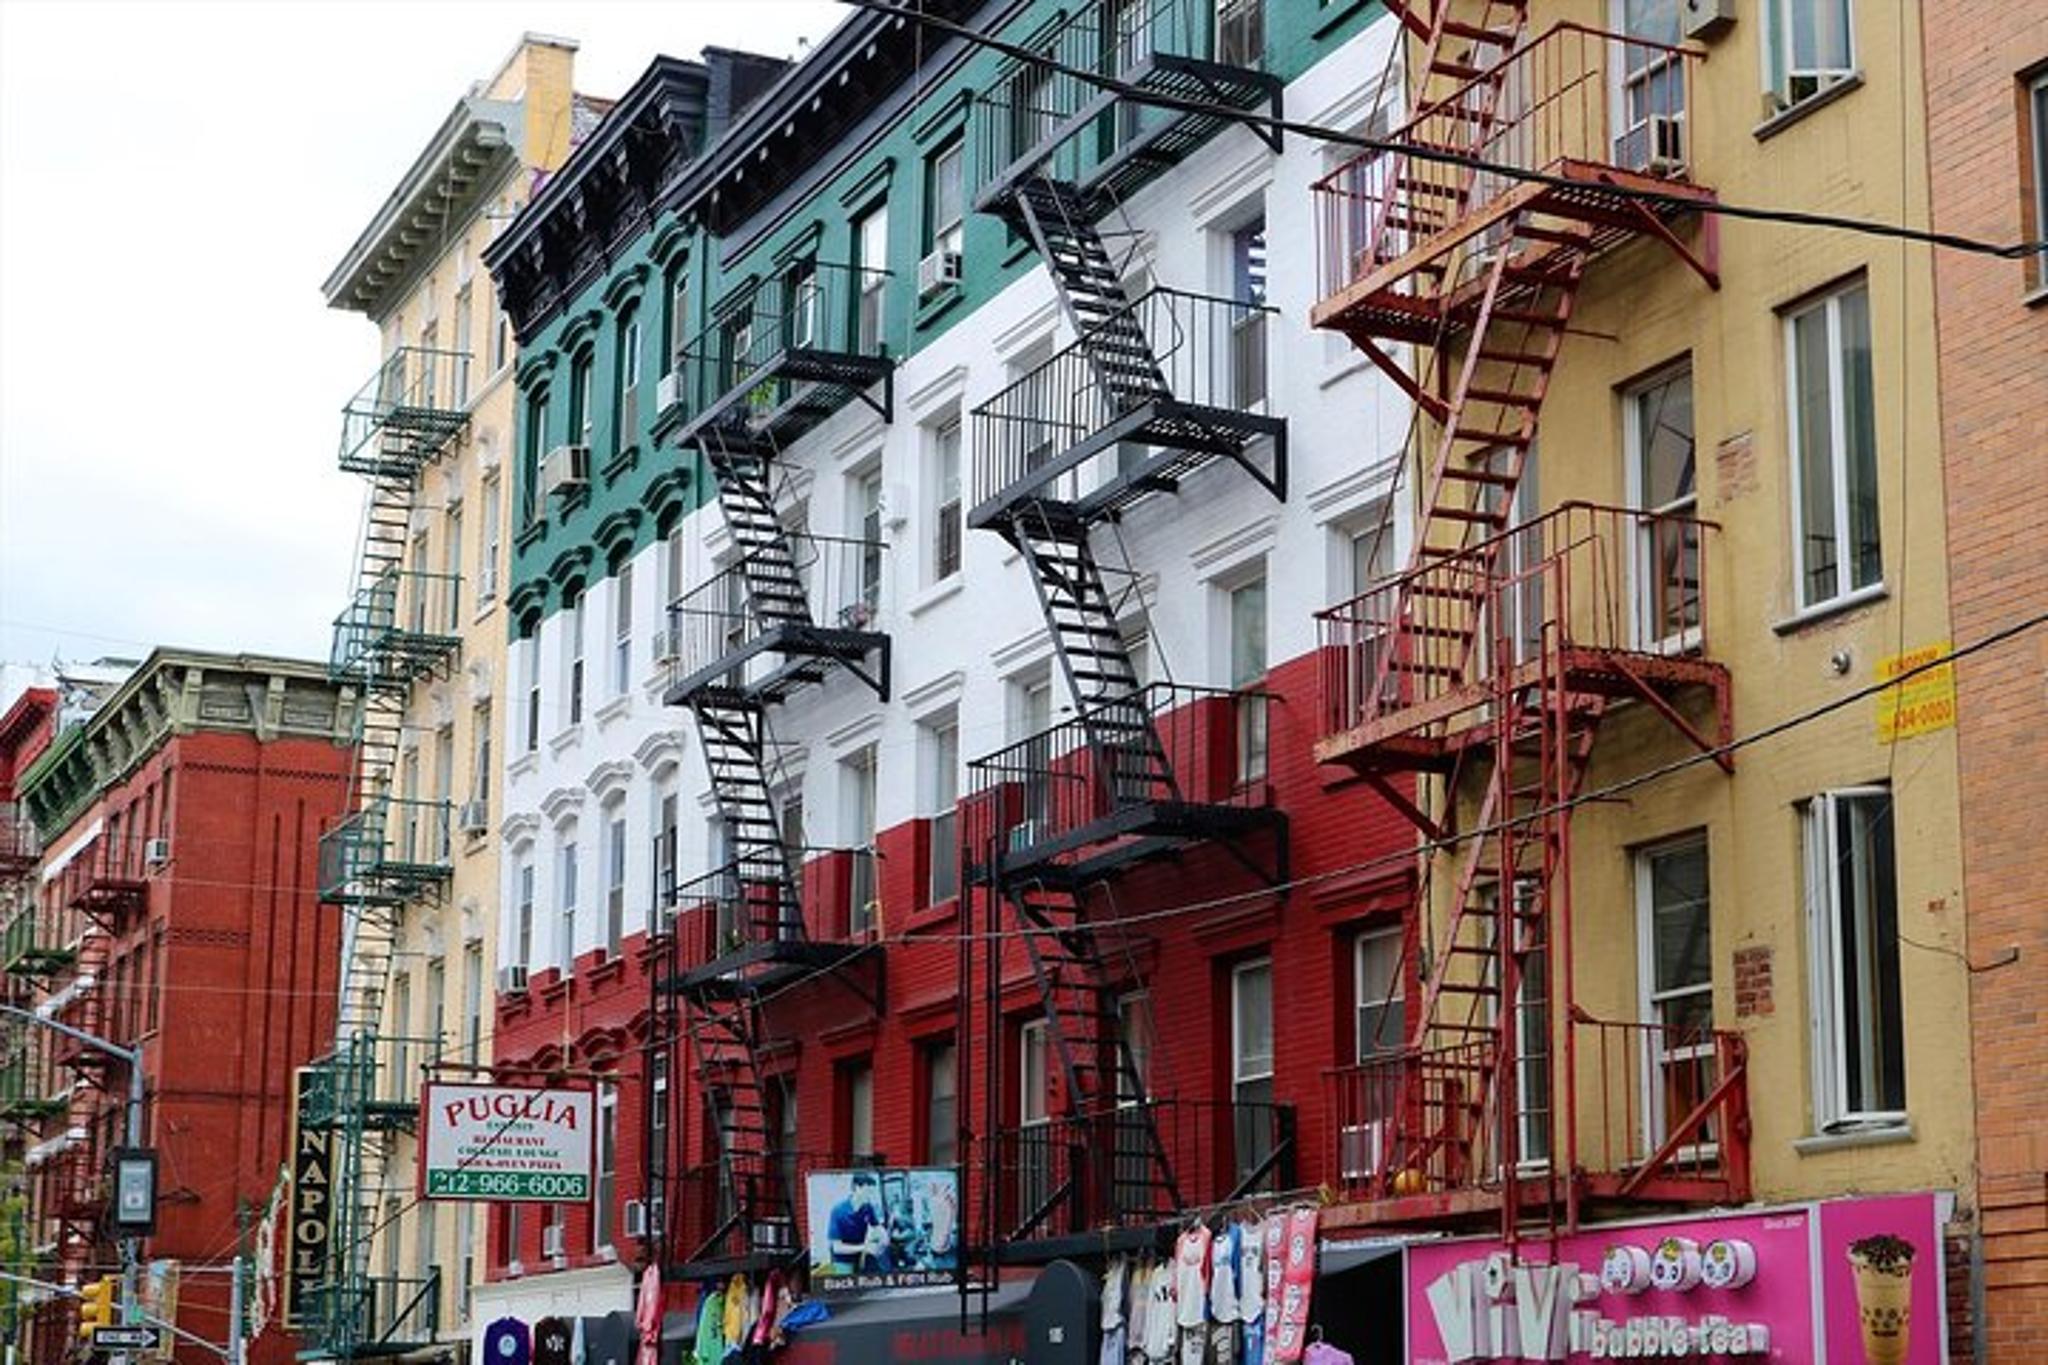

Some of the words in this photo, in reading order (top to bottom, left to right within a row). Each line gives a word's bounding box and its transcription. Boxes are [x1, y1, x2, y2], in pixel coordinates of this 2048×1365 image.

[444, 1094, 577, 1130] PUGLIA
[473, 1135, 546, 1146] RETAURANT
[433, 1169, 584, 1196] 212-966-6006
[823, 1276, 854, 1289] Back
[1592, 1316, 1687, 1357] bubble
[1699, 1314, 1766, 1355] tea
